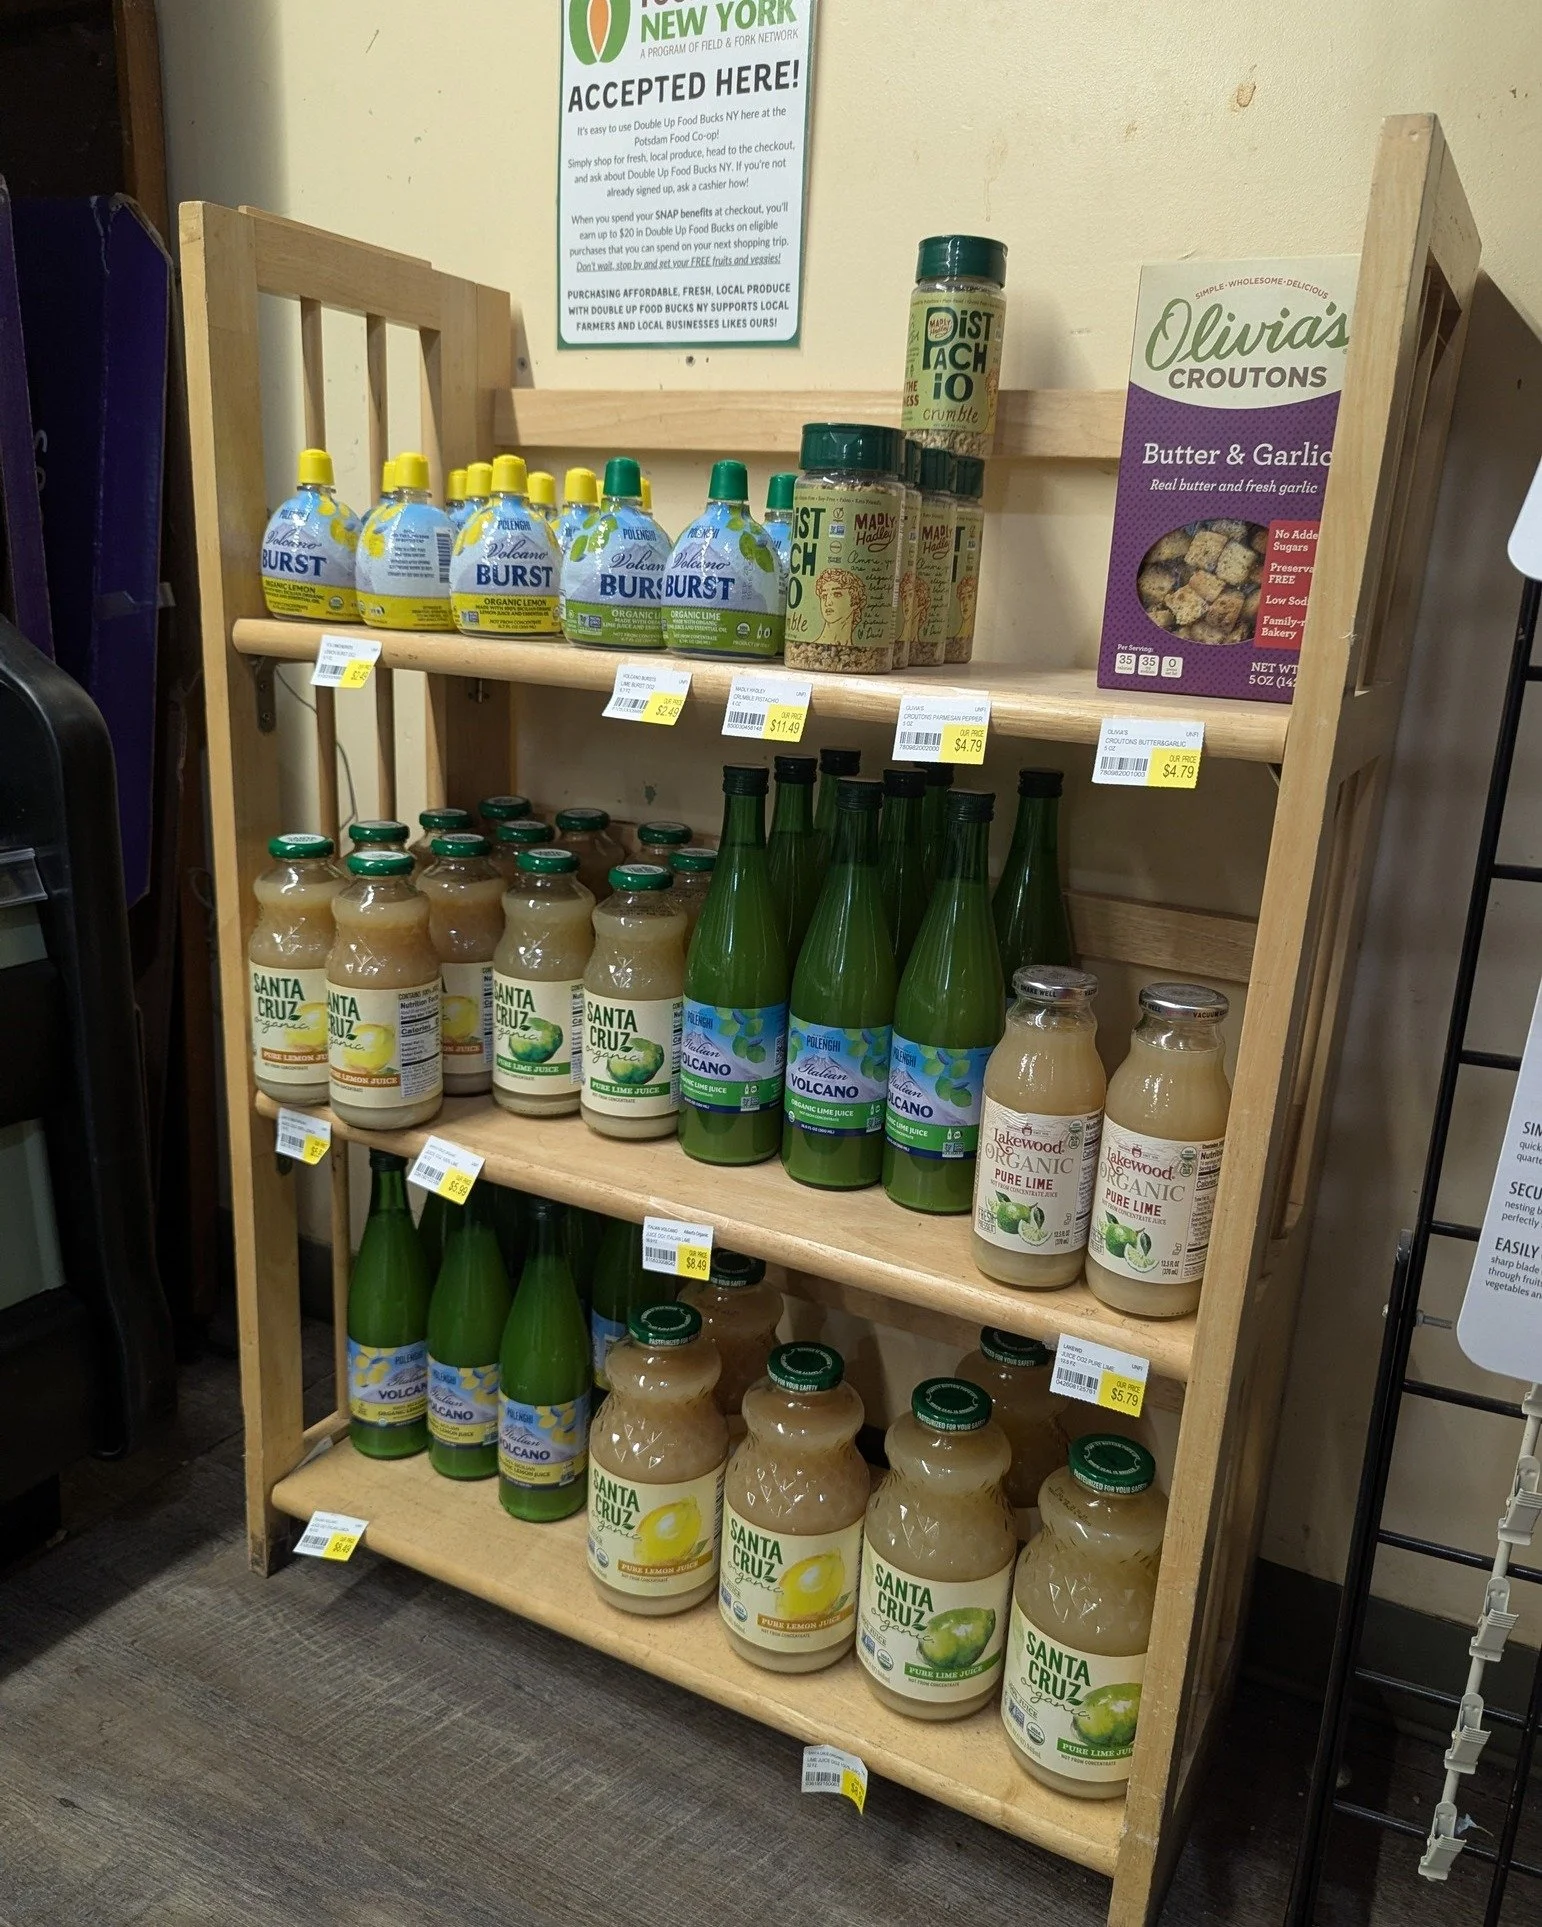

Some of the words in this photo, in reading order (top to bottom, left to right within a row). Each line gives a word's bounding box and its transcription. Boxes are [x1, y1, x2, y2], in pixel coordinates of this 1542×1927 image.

[641, 6, 707, 42] NEW
[717, 0, 797, 32] YORK
[640, 48, 645, 58] A
[648, 43, 685, 57] PROGRAM
[688, 41, 699, 54] OF
[701, 38, 723, 51] FIELD
[725, 37, 731, 47] &
[734, 34, 755, 46] FORK
[758, 28, 797, 43] NETWORK
[568, 72, 705, 112] ACCEPTED
[716, 59, 798, 96] HERE!
[577, 126, 588, 135] It's
[589, 126, 606, 135] easy
[608, 124, 616, 132] to
[618, 123, 631, 131] use
[634, 119, 661, 130] Double
[663, 117, 675, 128] Up
[677, 115, 697, 125] Food
[700, 113, 723, 123] Bucks
[726, 111, 738, 121] NY
[741, 109, 759, 119] here
[761, 108, 769, 117] at
[772, 106, 786, 116] the
[634, 135, 667, 146] Potsdam
[669, 132, 689, 143] Food
[692, 129, 718, 142] Co-op!
[567, 289, 620, 299] PURCHASING
[623, 287, 679, 297] AFFORDABLE,
[683, 286, 712, 295] FRESH,
[716, 284, 744, 294] LOCAL
[747, 283, 790, 293] PRODUCE
[568, 306, 588, 314] WITH
[591, 305, 622, 314] DOUBLE
[625, 305, 637, 313] UP
[639, 304, 662, 313] FOOD
[665, 303, 693, 312] BUCKS
[696, 303, 708, 311] NY
[711, 301, 757, 311] SUPPORTS
[760, 301, 788, 310] LOCAL
[576, 321, 615, 330] FARMERS
[617, 321, 635, 329] AND
[637, 320, 663, 329] LOCAL
[666, 319, 718, 329] BUSINESSES
[722, 318, 746, 328] LIKES
[749, 318, 776, 327] OURS!
[1145, 299, 1350, 371] Olivia's
[1168, 367, 1327, 389] CROUTONS
[923, 407, 978, 424] crumble
[1143, 443, 1220, 464] Butter
[1226, 444, 1245, 464] &
[1253, 443, 1332, 466] Garlic
[1149, 479, 1177, 490] Real
[1178, 479, 1216, 490] butter
[1218, 481, 1243, 491] and
[1245, 481, 1276, 492] fresh
[1278, 482, 1317, 495] garlic
[854, 513, 896, 531] MADLY
[855, 528, 896, 552] Hadley
[1275, 530, 1289, 539] No
[1292, 530, 1318, 540] Adde
[488, 540, 548, 560] Volcano
[1273, 542, 1308, 553] Sugars
[262, 550, 327, 577] BURST
[476, 564, 552, 588] BURST
[1268, 575, 1295, 584] FREE
[666, 575, 735, 600] BURST
[484, 598, 520, 606] ORGANIC
[1266, 595, 1286, 605] Low
[1288, 596, 1308, 606] Sod
[701, 612, 720, 620] LIME
[1262, 628, 1296, 639] Bakery
[1119, 655, 1132, 664] 35
[1142, 657, 1155, 666] 35
[1251, 662, 1276, 673] NET
[656, 705, 679, 717] $2.49
[770, 719, 800, 734] $11.49
[955, 738, 982, 752] $4.79
[1163, 764, 1194, 778] $4.79
[254, 972, 305, 1001] SANTA
[258, 996, 302, 1020] CRUZ
[587, 1001, 638, 1032] SANTA
[589, 1028, 633, 1051] CRUZ
[611, 1086, 633, 1094] LIME
[791, 1076, 859, 1099] VOLCANO
[791, 1098, 815, 1114] ORGANIC
[816, 1108, 833, 1116] LIME
[834, 1109, 854, 1117] JUICE
[985, 1143, 1074, 1175] ORGANIC
[449, 1181, 468, 1196] $5.99
[995, 1168, 1022, 1188] PURE
[1025, 1175, 1053, 1191] LIME
[1100, 1162, 1186, 1202] ORGANIC
[1106, 1187, 1131, 1207] PURE
[1134, 1198, 1161, 1216] LIME
[1505, 1201, 1535, 1215] nesting
[1502, 1213, 1539, 1229] perfectly
[1495, 1237, 1540, 1258] EASILY
[687, 1257, 706, 1271] $8.49
[1491, 1256, 1514, 1269] sharp
[1516, 1261, 1539, 1274] blade
[1488, 1267, 1520, 1282] through
[1485, 1280, 1529, 1296] vegetables
[1111, 1388, 1138, 1406] $5.79
[593, 1468, 640, 1513] SANTA
[595, 1493, 636, 1531] CRUZ
[730, 1518, 783, 1565] SANTA
[621, 1562, 643, 1573] PURE
[645, 1564, 671, 1575] LEMON
[673, 1561, 699, 1573] JUICE
[732, 1545, 781, 1585] CRUZ
[874, 1563, 934, 1613] SANTA
[877, 1593, 928, 1632] CRUZ
[1025, 1631, 1090, 1688] SANTA
[909, 1665, 933, 1678] PURE
[935, 1668, 957, 1678] LIME
[959, 1664, 983, 1676] JUICE
[1028, 1662, 1085, 1706] CRUZ
